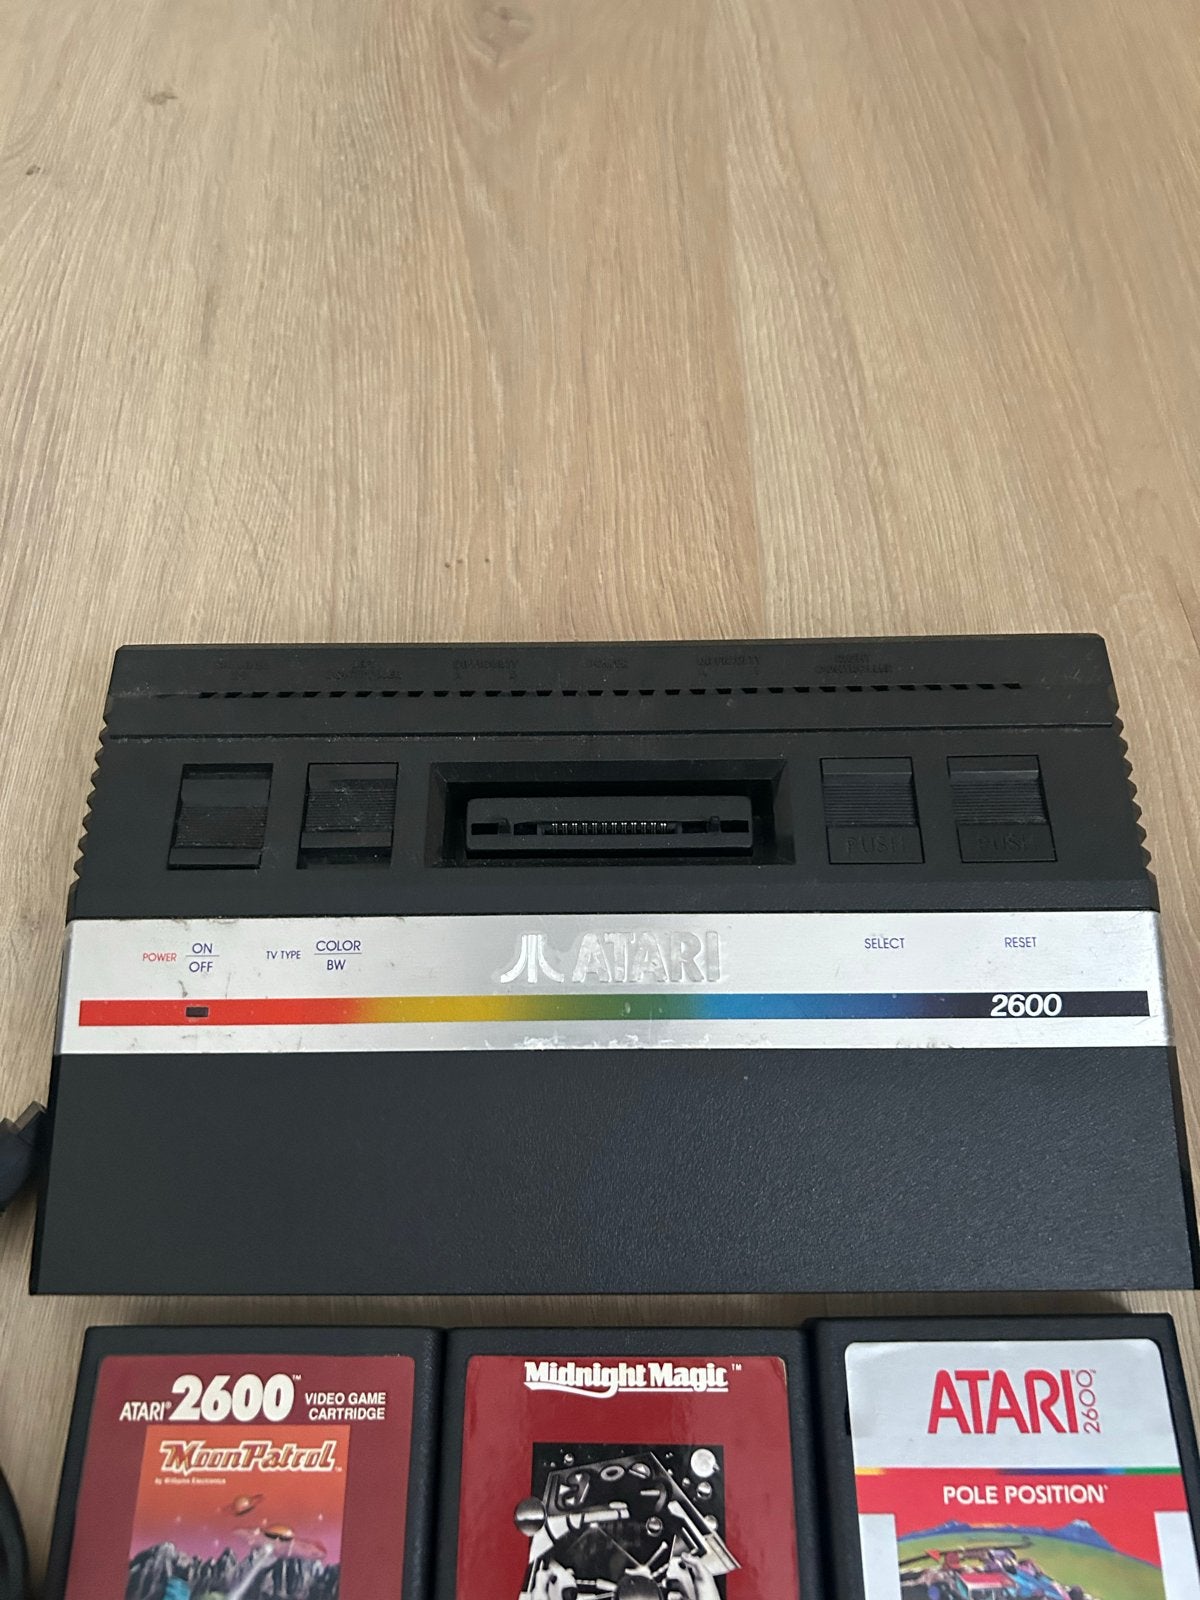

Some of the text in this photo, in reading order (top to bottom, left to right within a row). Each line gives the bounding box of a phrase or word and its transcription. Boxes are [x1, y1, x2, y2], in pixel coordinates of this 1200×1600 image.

[191, 942, 213, 954] ON
[315, 939, 362, 952] COLOR
[864, 937, 905, 950] SELECT
[1004, 936, 1037, 948] RESET
[142, 952, 177, 962] POWER
[266, 950, 302, 960] TV TYPE
[572, 931, 721, 983] ATARI
[188, 961, 214, 973] OFF
[326, 959, 346, 971] BW
[990, 993, 1062, 1017] 2600
[523, 1361, 647, 1398] Midnight
[648, 1362, 729, 1392] Magic
[168, 1373, 294, 1422] 2600
[304, 1392, 387, 1405] VIDEO GAME
[927, 1369, 1079, 1435] ATARI
[1075, 1369, 1101, 1434] 2600
[308, 1407, 386, 1421] CARTRIDGE
[943, 1484, 1105, 1505] POLE POSITION
